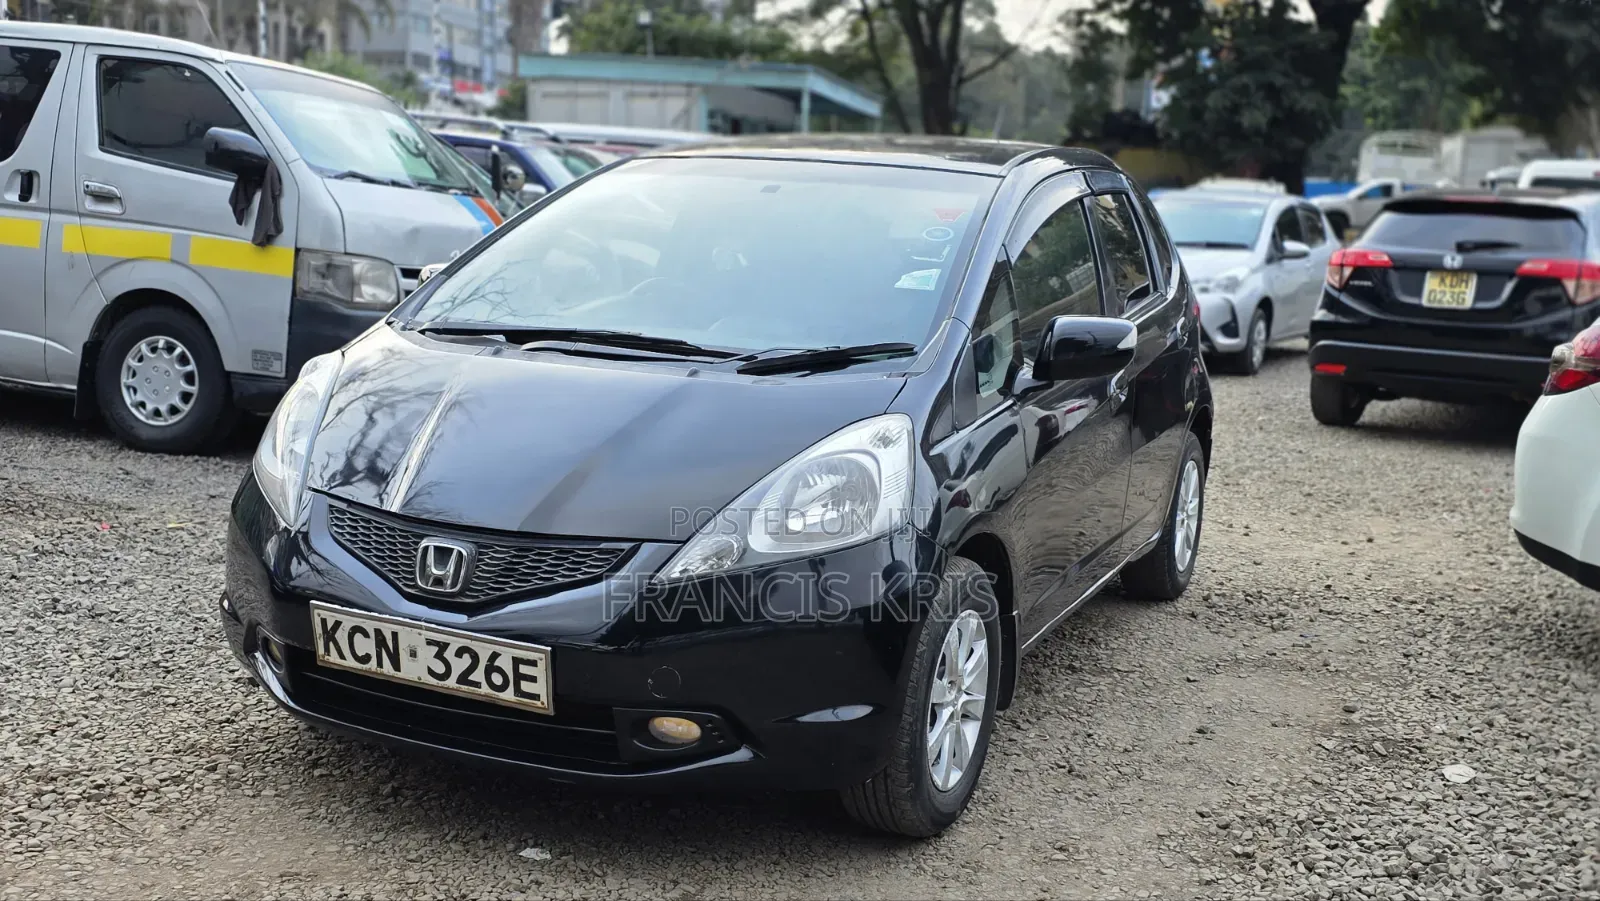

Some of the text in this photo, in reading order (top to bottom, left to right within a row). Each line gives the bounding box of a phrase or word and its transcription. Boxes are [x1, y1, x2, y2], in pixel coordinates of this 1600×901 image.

[1438, 272, 1469, 288] KDH
[1427, 289, 1466, 305] 023G
[319, 617, 541, 701] KCN 326E
